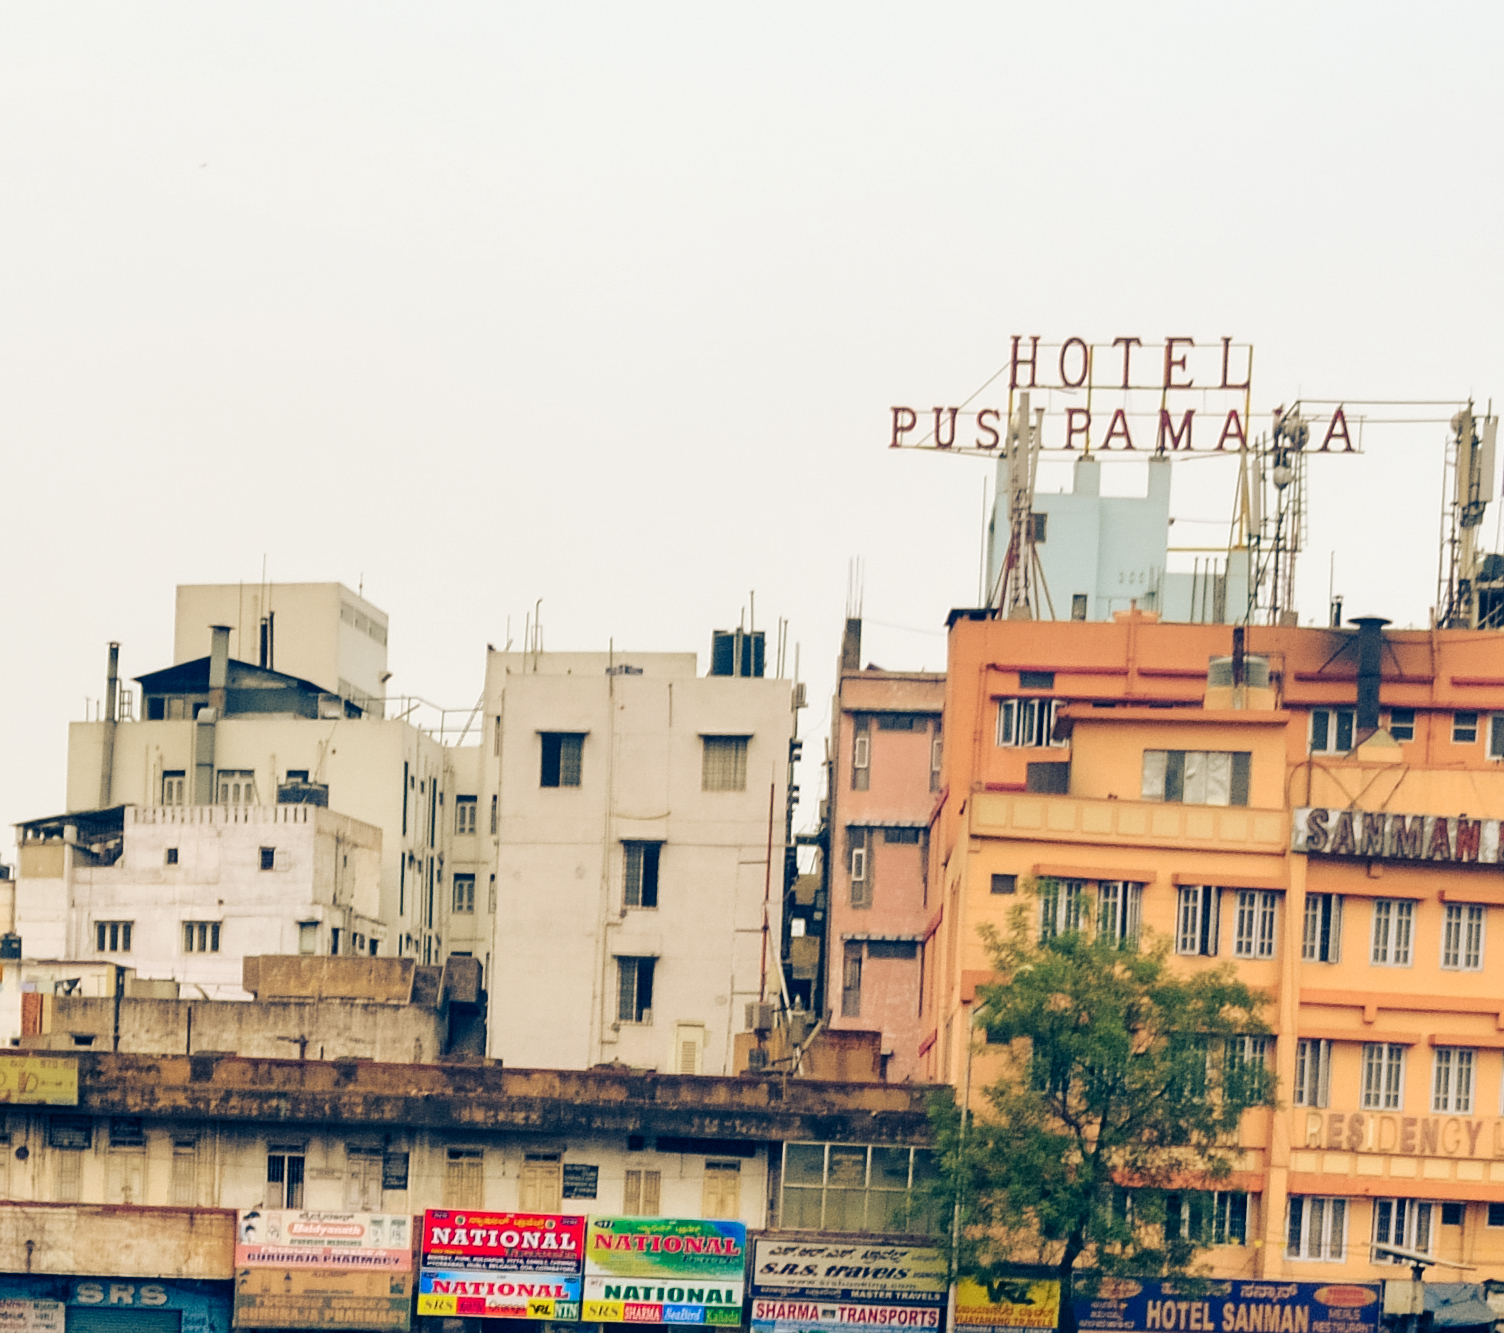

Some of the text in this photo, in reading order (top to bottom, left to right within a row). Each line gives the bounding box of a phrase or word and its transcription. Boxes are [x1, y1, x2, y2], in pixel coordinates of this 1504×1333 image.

[1009, 335, 1251, 390] HOTEL
[1305, 808, 1483, 863] SANMAN
[1305, 1112, 1484, 1157] RESIDENCY
[430, 1227, 576, 1250] NATIONAL
[594, 1234, 741, 1256] NATIONAL
[247, 1253, 400, 1267] GURURAJA PHARMACY
[825, 1264, 911, 1280] travels
[77, 1283, 168, 1306] SRS
[432, 1280, 569, 1298] NATIONAL
[604, 1285, 737, 1304] NATIONAL
[896, 1292, 941, 1301] TRAVELS
[425, 1300, 453, 1310] SRS
[589, 1305, 618, 1317] SRS
[625, 1304, 661, 1322] SHARMA
[756, 1303, 820, 1321] SHARMA
[838, 1306, 938, 1326] TRANSPORTS
[1147, 1300, 1214, 1331] HOTEL
[1222, 1304, 1310, 1333] SANMAN
